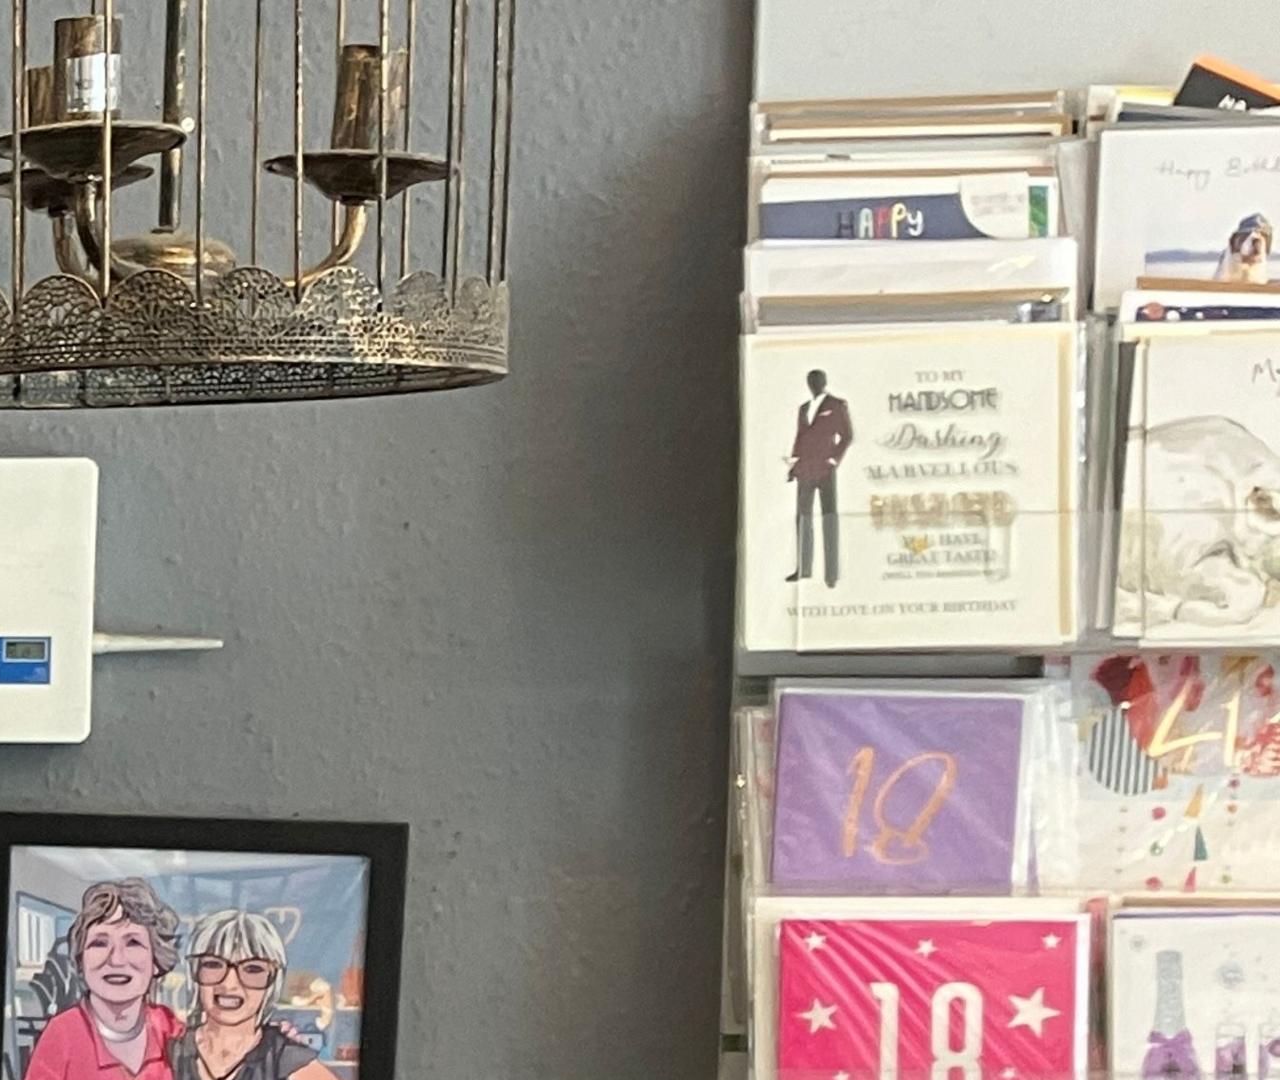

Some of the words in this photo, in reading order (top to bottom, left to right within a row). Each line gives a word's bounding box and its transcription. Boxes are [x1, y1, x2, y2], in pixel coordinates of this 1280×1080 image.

[888, 387, 998, 413] HANDSOME
[877, 423, 1007, 460] Dashing
[864, 460, 1019, 480] MARVELLOUS
[902, 533, 936, 548] YU
[831, 604, 868, 616] LOVE
[899, 602, 938, 614] YOUR
[943, 599, 1017, 613] BIRTHDAY
